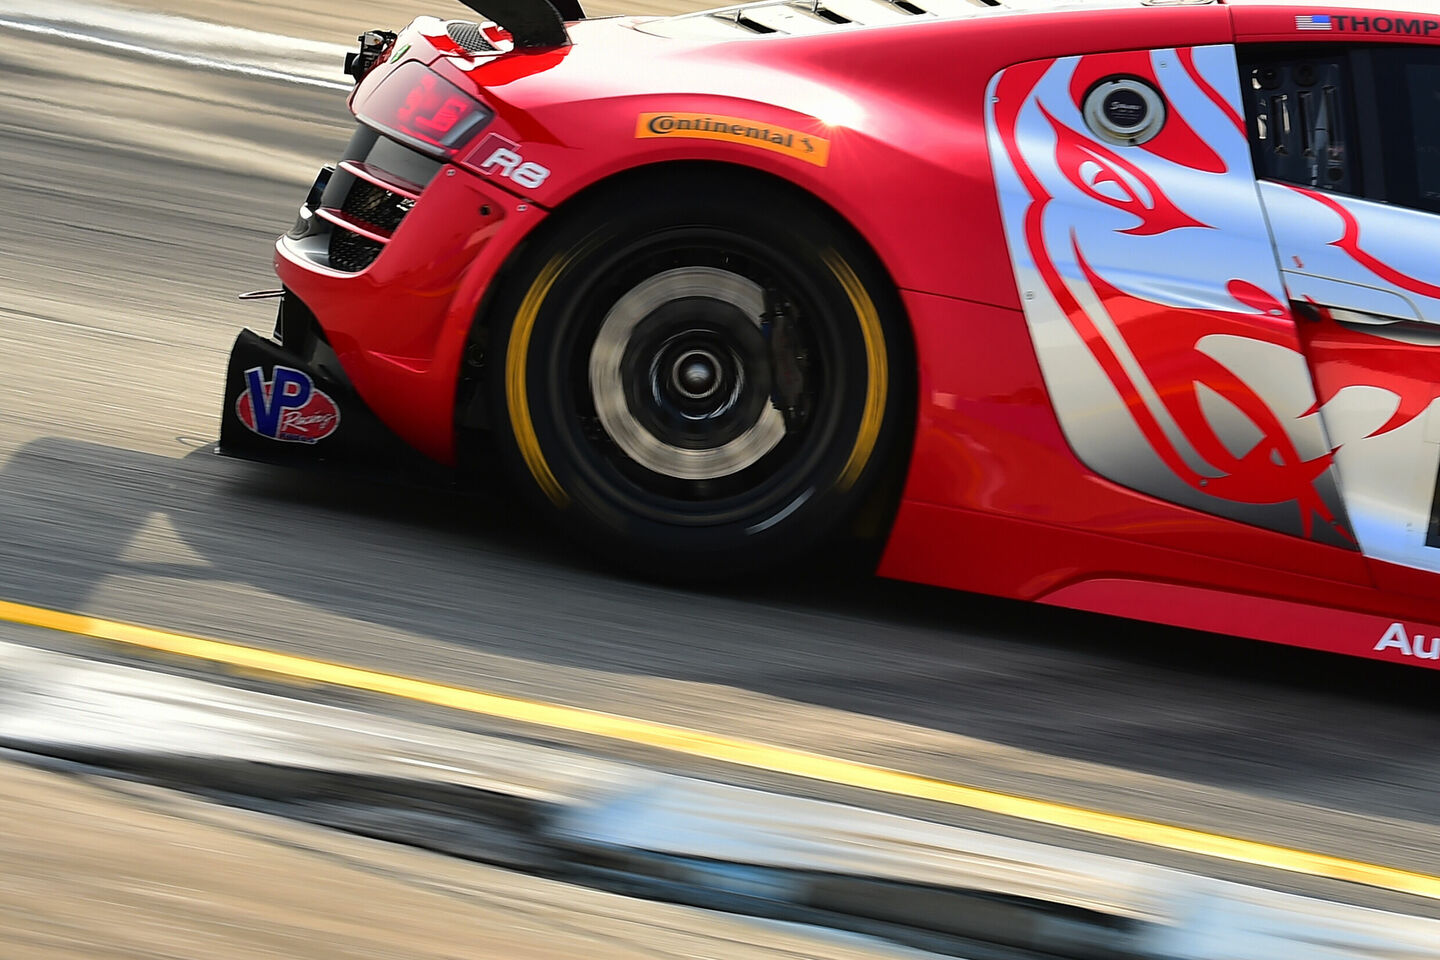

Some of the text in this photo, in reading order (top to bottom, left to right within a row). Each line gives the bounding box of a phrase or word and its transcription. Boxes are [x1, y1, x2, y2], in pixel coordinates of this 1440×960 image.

[648, 115, 794, 148] Continental
[481, 147, 551, 189] R8
[244, 365, 314, 440] VP
